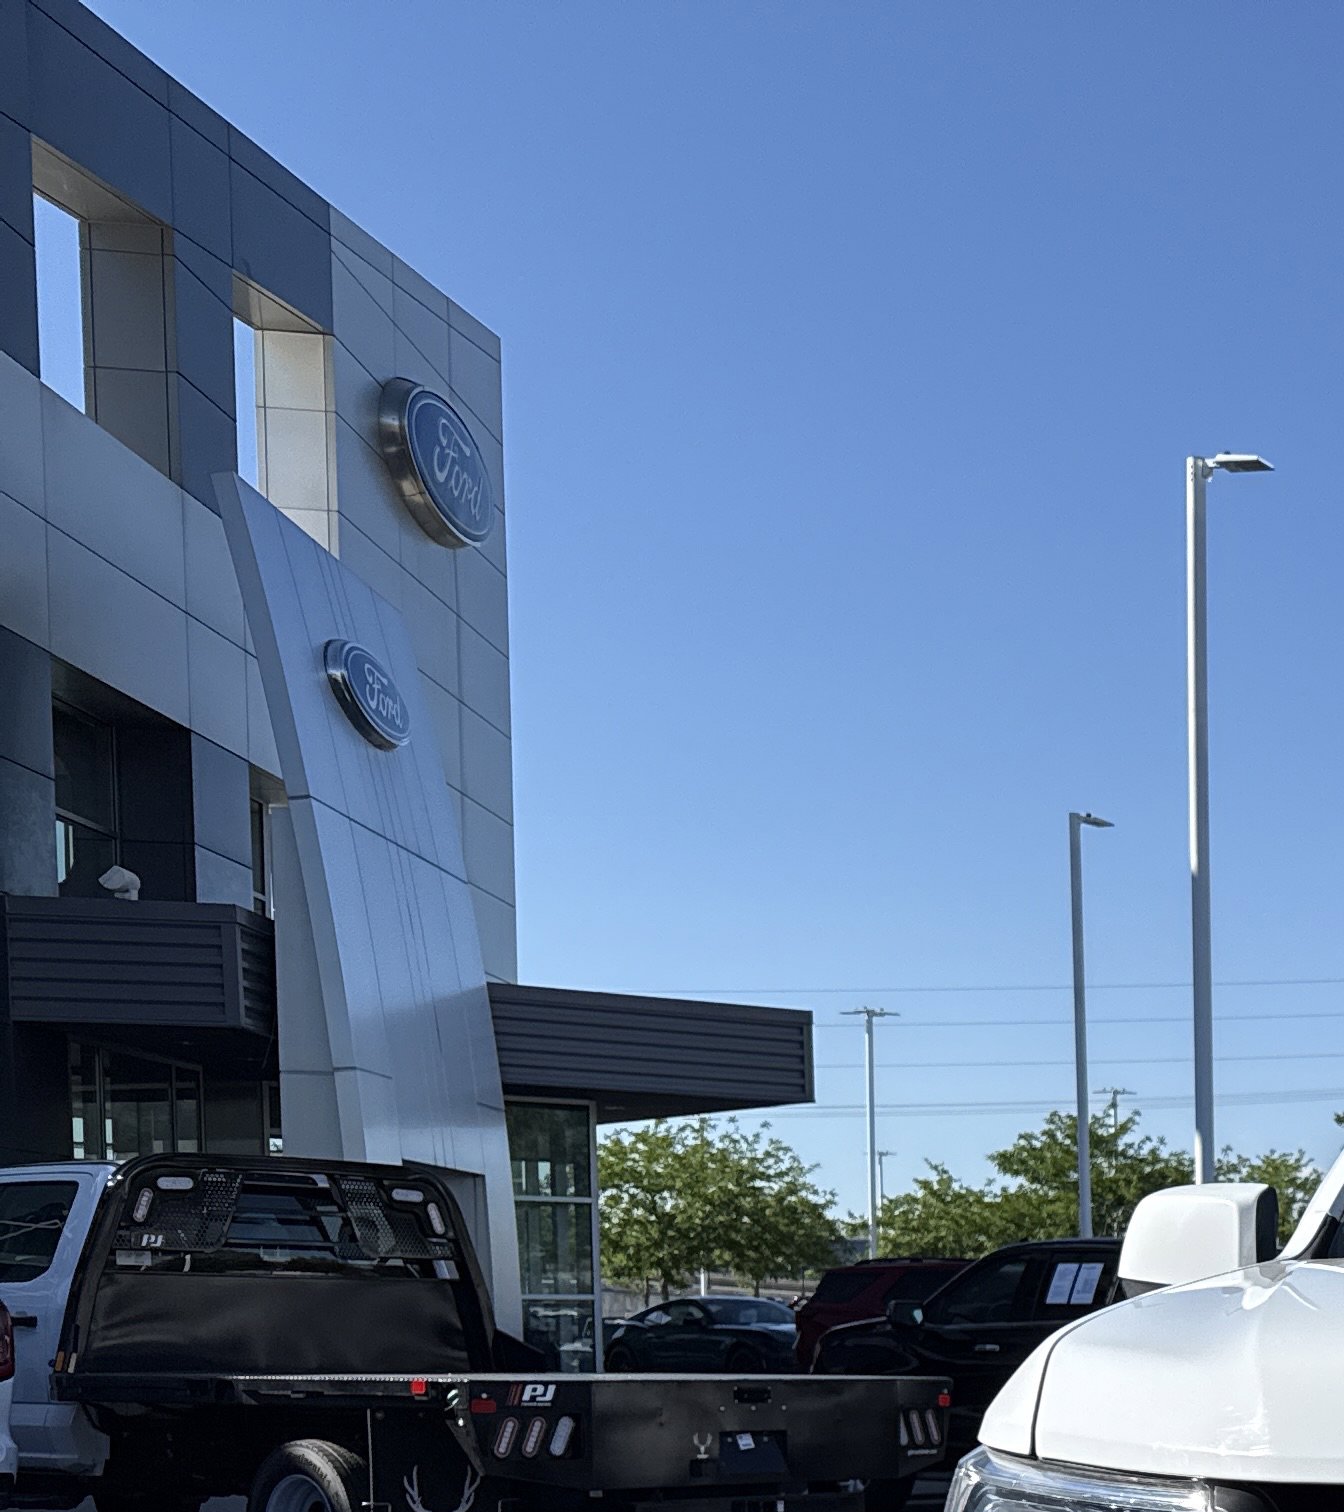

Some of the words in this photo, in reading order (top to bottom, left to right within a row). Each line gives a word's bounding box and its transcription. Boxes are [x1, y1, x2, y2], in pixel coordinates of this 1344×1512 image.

[433, 417, 483, 520] Ford
[365, 663, 403, 728] Ford
[141, 1233, 163, 1247] PJ
[521, 1384, 557, 1401] PJ
